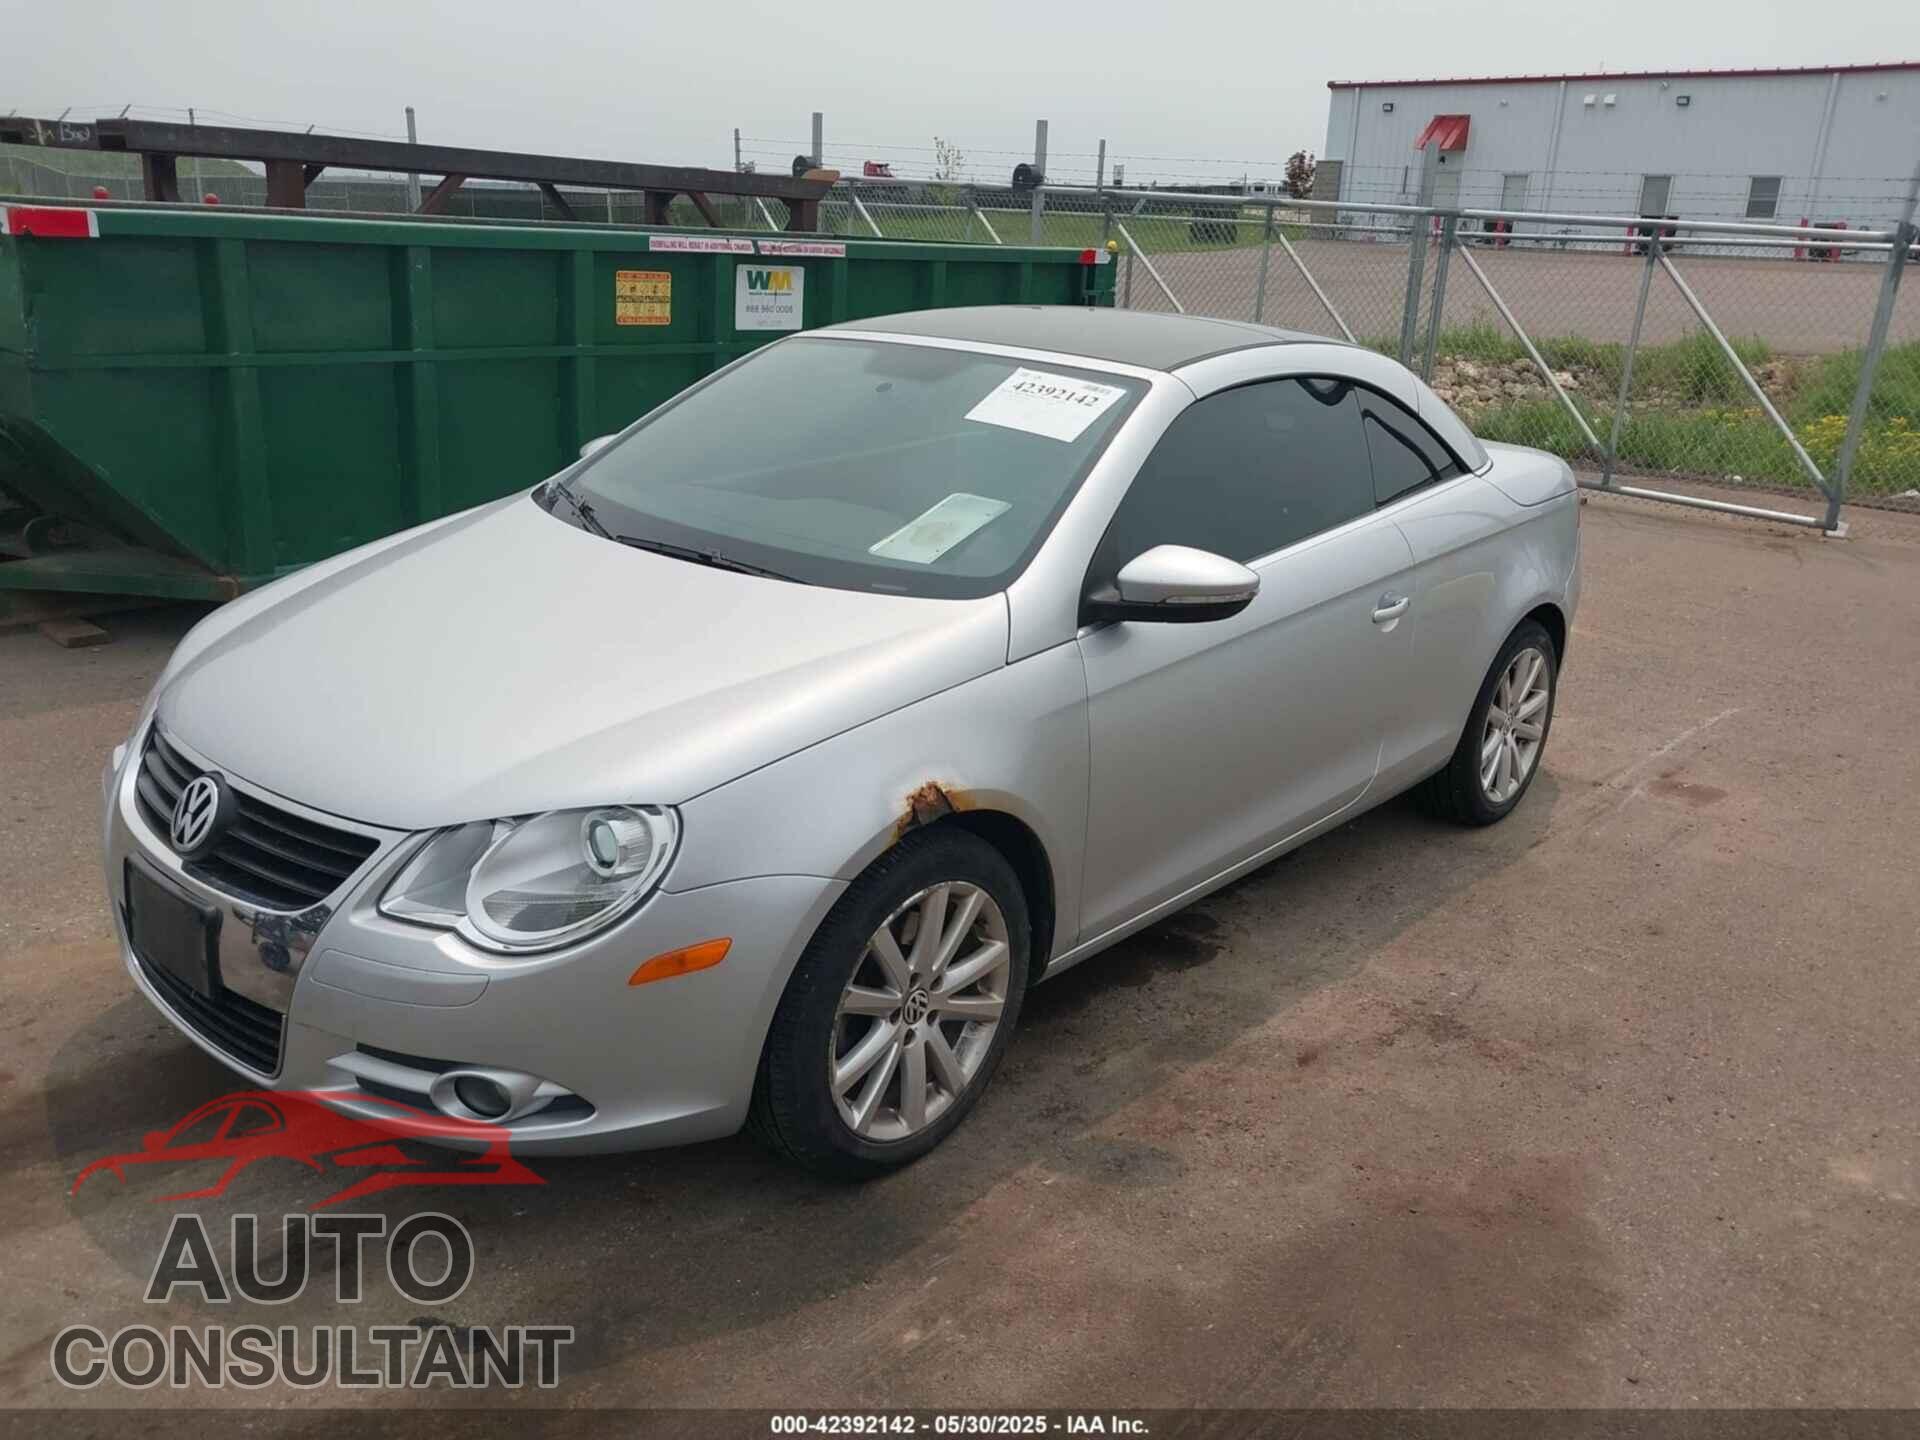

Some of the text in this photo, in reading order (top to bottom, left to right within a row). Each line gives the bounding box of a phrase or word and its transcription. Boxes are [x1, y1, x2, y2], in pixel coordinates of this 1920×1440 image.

[747, 270, 792, 290] WM
[1012, 381, 1100, 407] 42392142
[172, 777, 217, 851] VW
